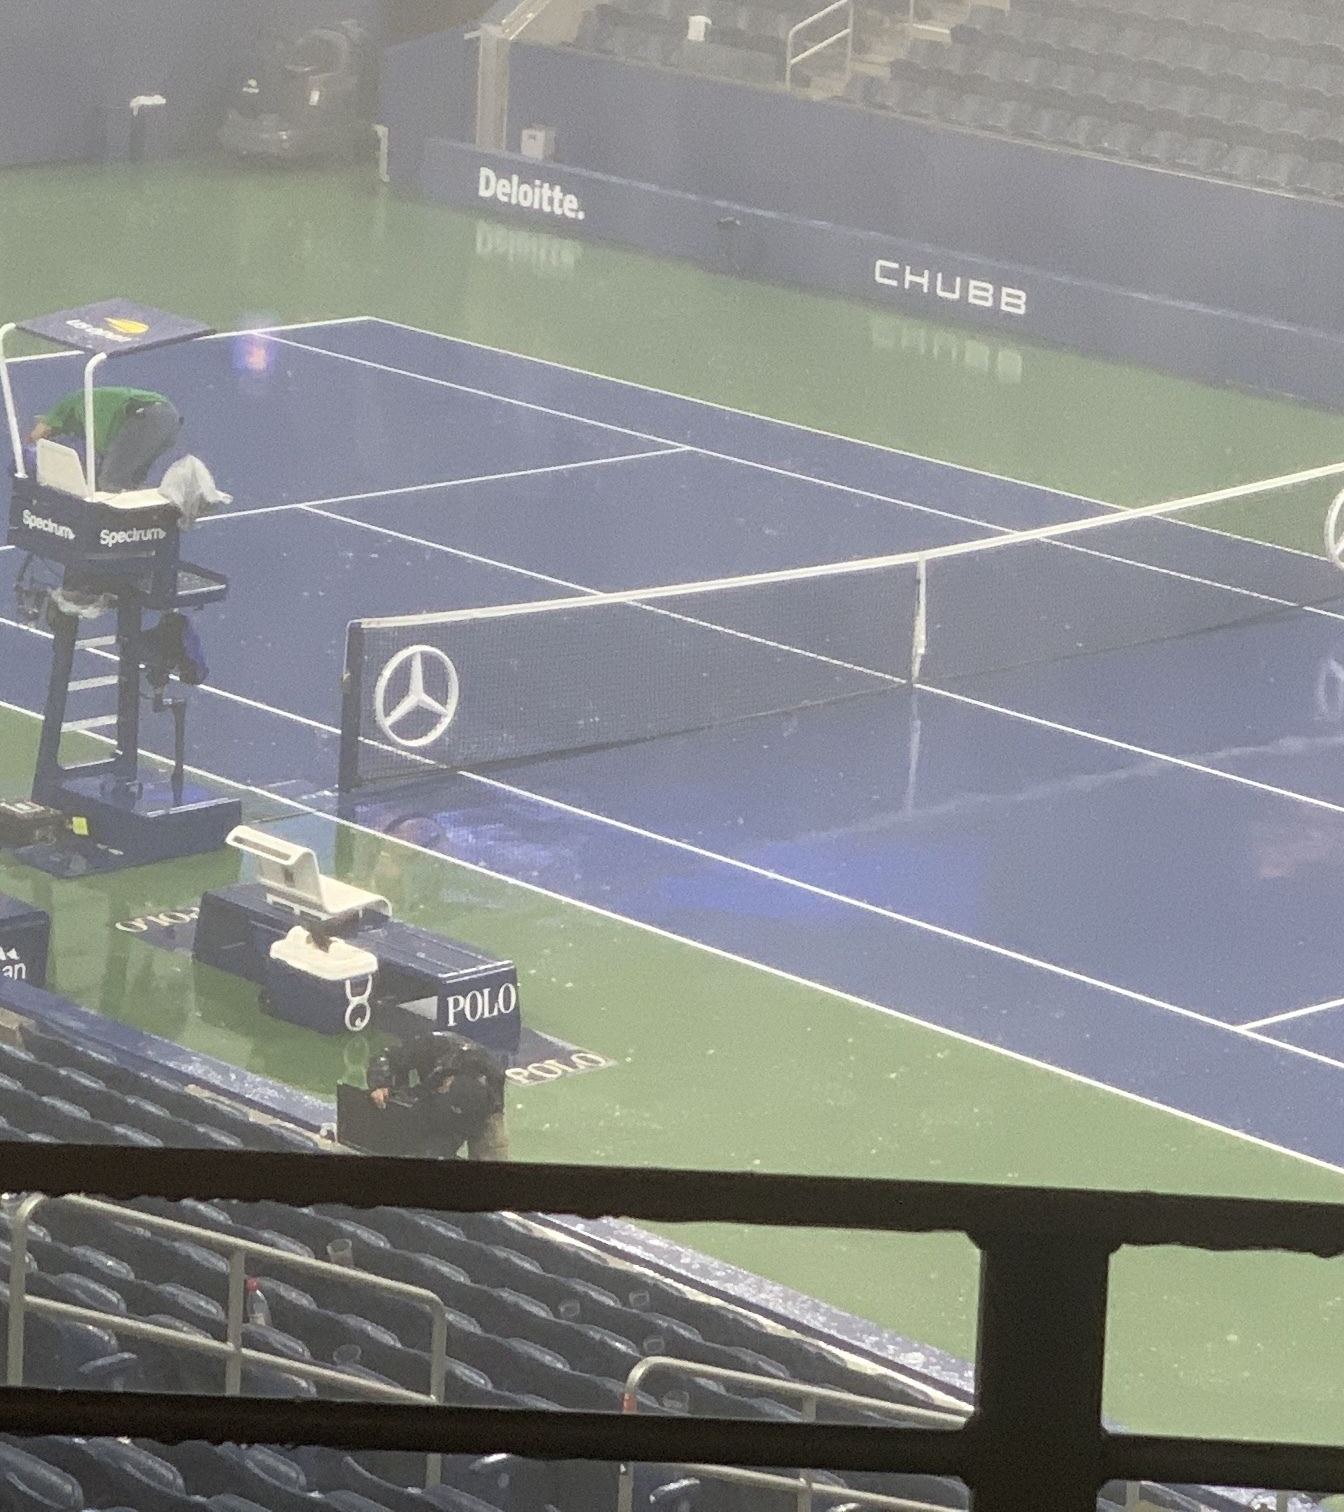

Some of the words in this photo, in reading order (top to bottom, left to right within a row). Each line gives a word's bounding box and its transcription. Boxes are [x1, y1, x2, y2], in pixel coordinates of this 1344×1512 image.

[478, 167, 585, 220] Deloitte.
[875, 259, 1027, 315] CHUBB
[22, 509, 73, 539] Spectrum
[100, 527, 163, 547] Spectrum
[446, 983, 517, 1026] POLO
[505, 1053, 606, 1084] POLO
